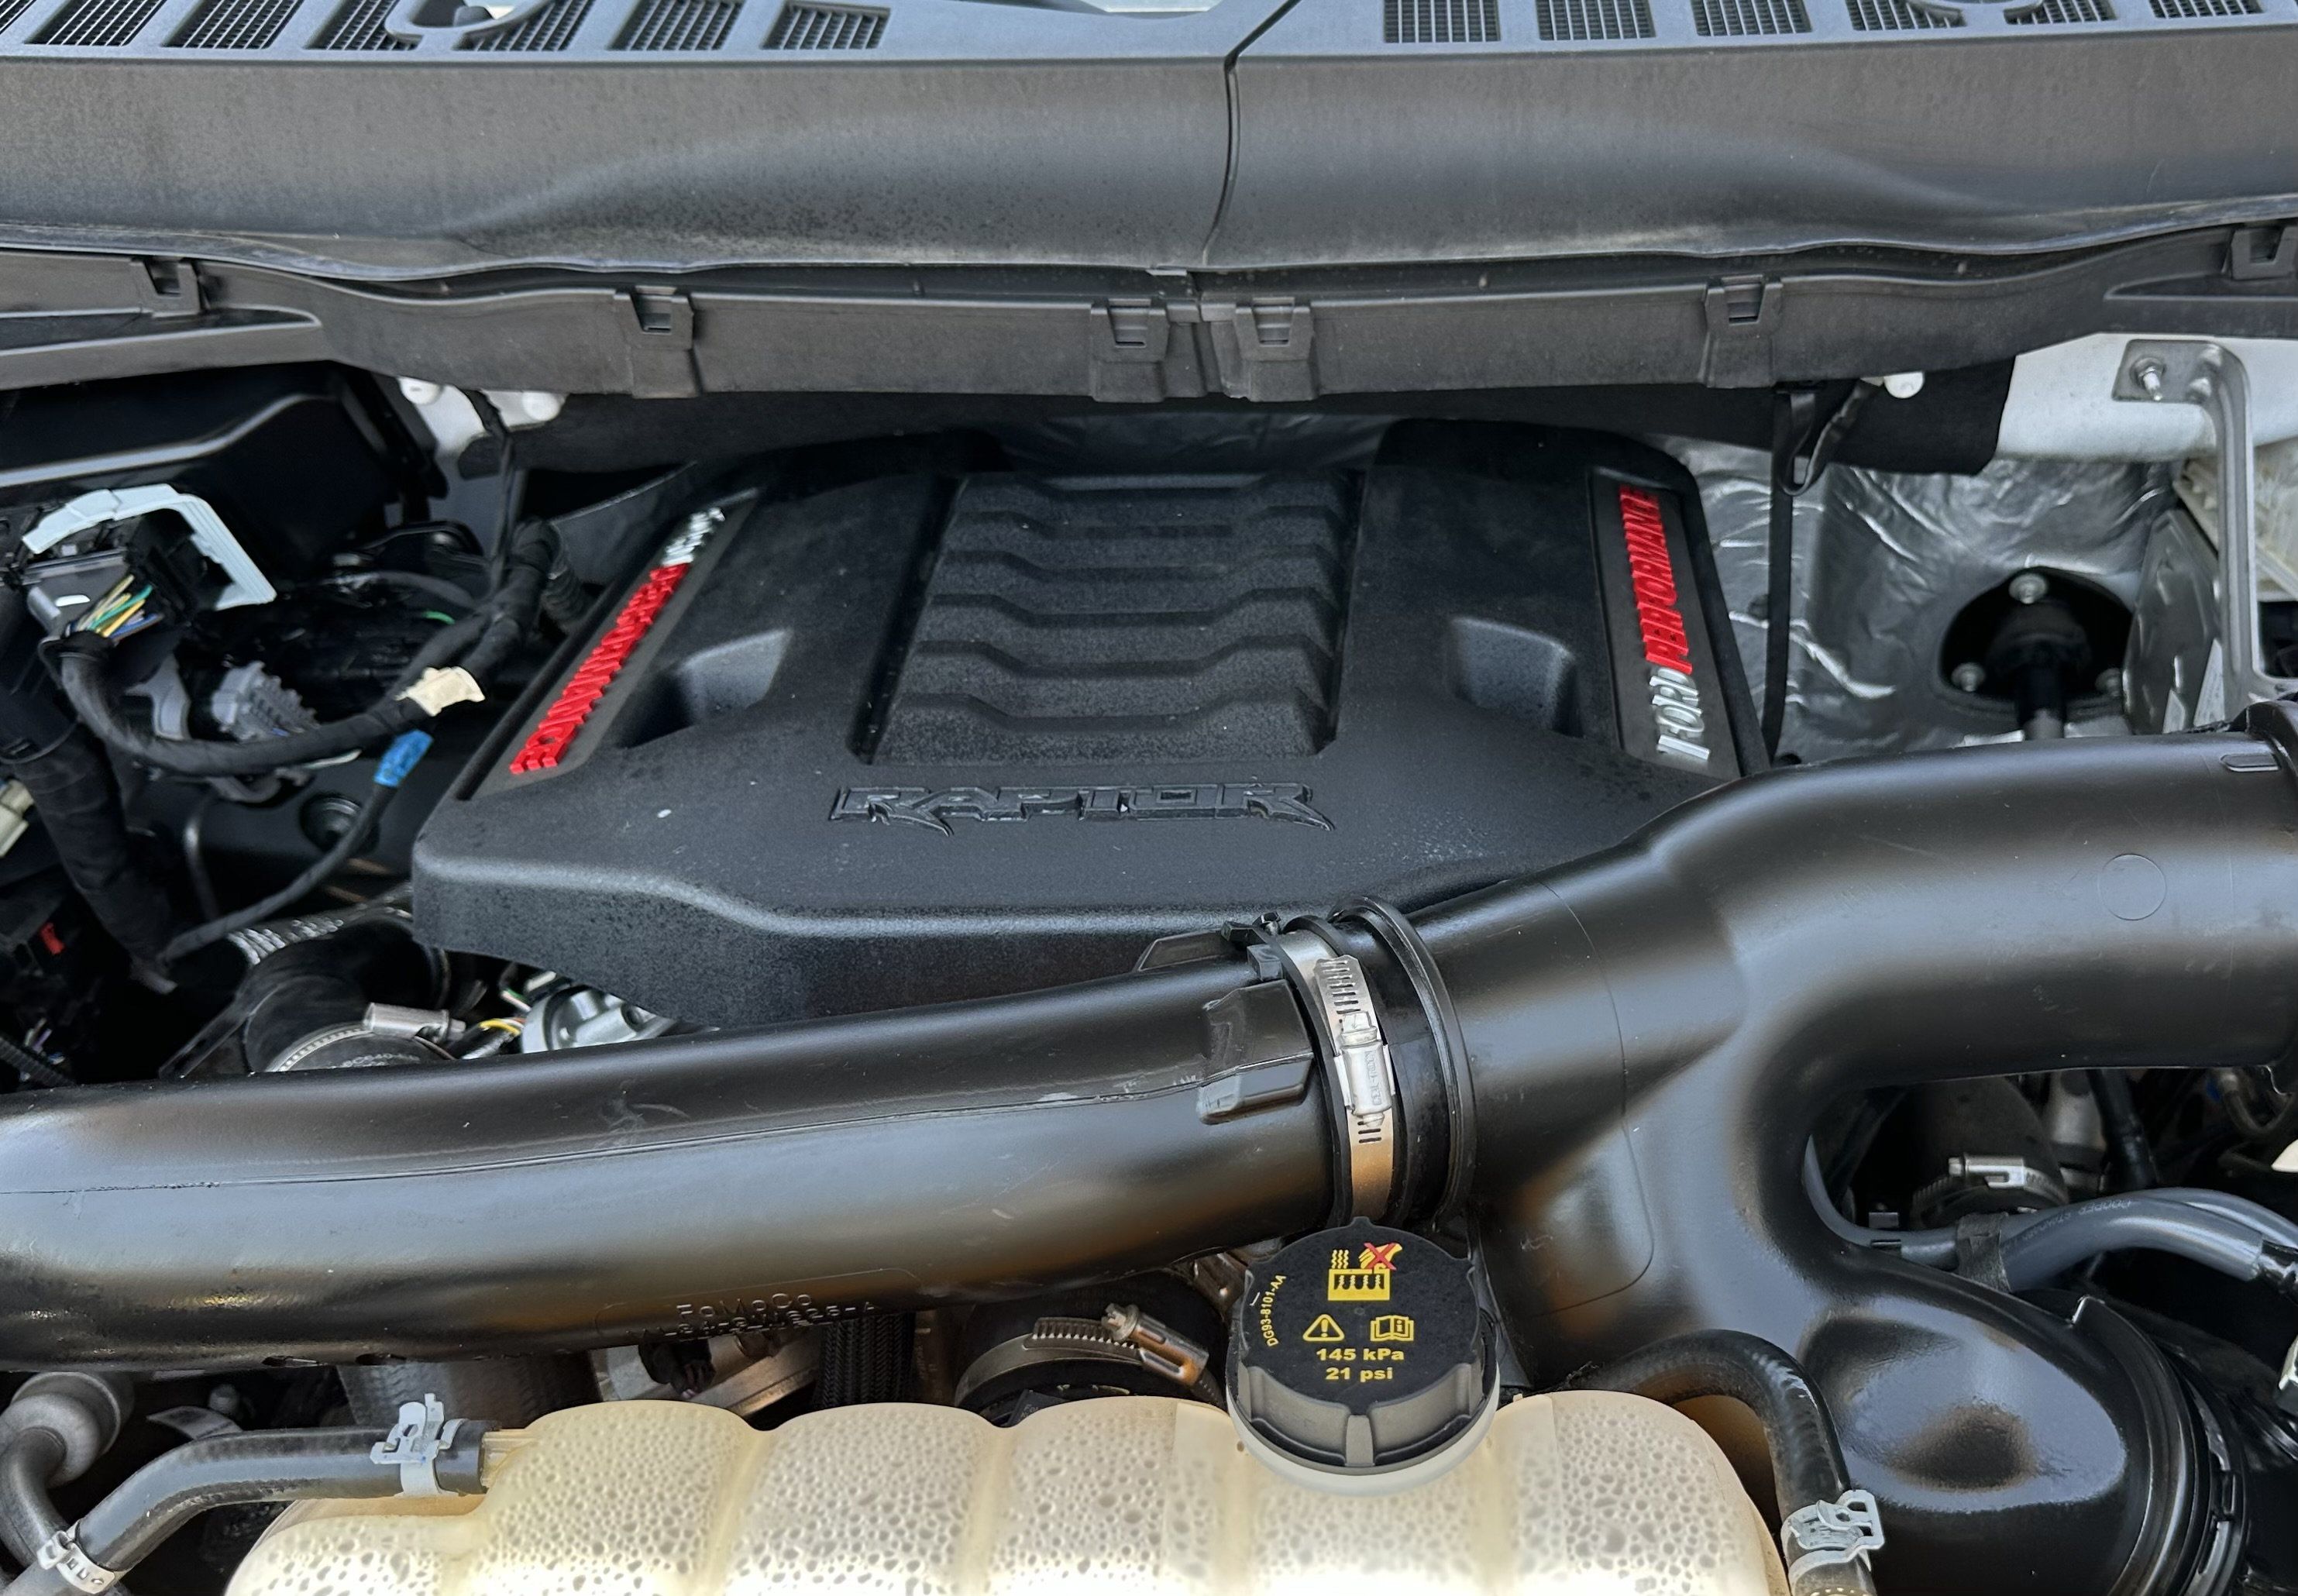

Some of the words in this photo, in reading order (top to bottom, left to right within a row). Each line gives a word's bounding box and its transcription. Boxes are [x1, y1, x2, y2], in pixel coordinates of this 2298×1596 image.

[1619, 485, 1694, 676] PERFORMANCE
[1649, 668, 1711, 760] FORD
[827, 783, 1335, 838] RAPTOR
[1261, 1274, 1287, 1348] DG93-8101-AA
[1316, 1348, 1357, 1361] 145
[1363, 1348, 1405, 1361] kPa
[1325, 1367, 1350, 1381] 21
[1359, 1367, 1394, 1383] psi
